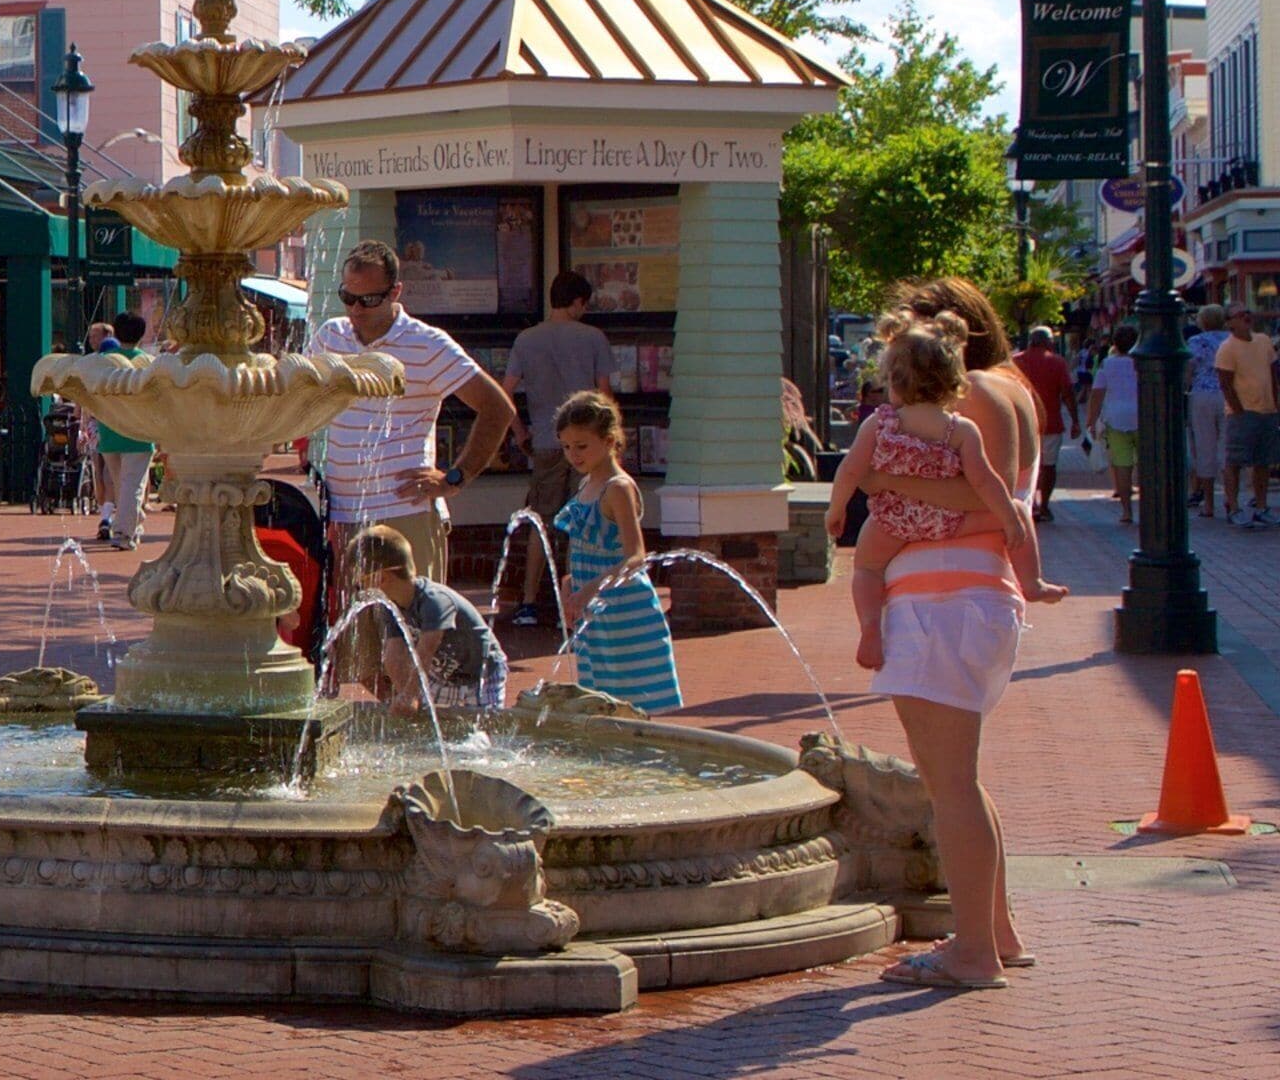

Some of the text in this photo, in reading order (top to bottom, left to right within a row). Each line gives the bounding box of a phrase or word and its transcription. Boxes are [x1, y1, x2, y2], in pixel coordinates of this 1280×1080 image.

[1032, 3, 1123, 20] Welcome
[1042, 52, 1126, 97] W
[378, 145, 429, 175] Friends
[434, 140, 460, 170] Old
[463, 141, 474, 168] &
[525, 138, 587, 173] Linger
[592, 139, 632, 167] Here
[637, 140, 649, 167] A
[654, 139, 686, 177] Day
[692, 140, 720, 168] Or
[95, 225, 131, 246] W
